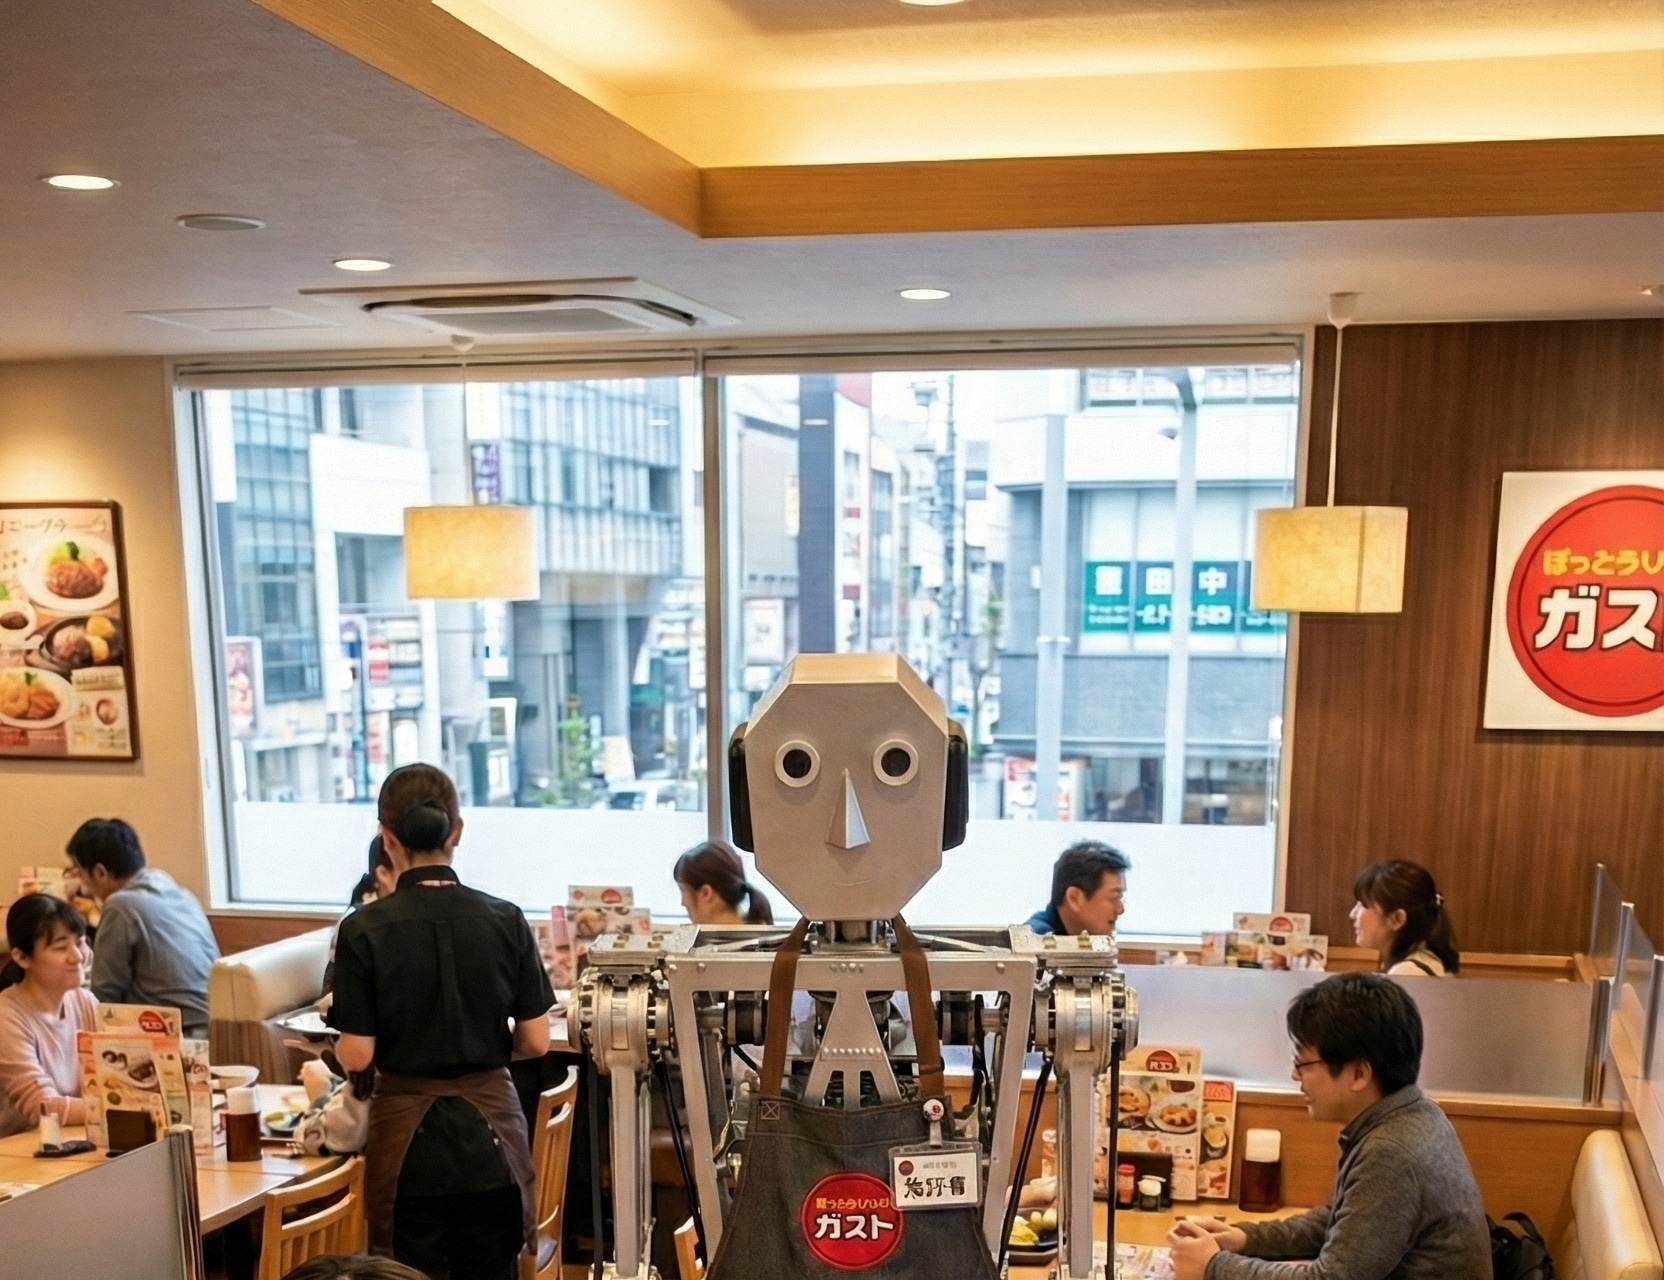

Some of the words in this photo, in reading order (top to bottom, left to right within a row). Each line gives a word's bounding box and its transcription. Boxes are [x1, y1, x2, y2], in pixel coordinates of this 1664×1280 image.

[1533, 584, 1664, 650] ガス
[814, 1213, 894, 1240] ガスト
